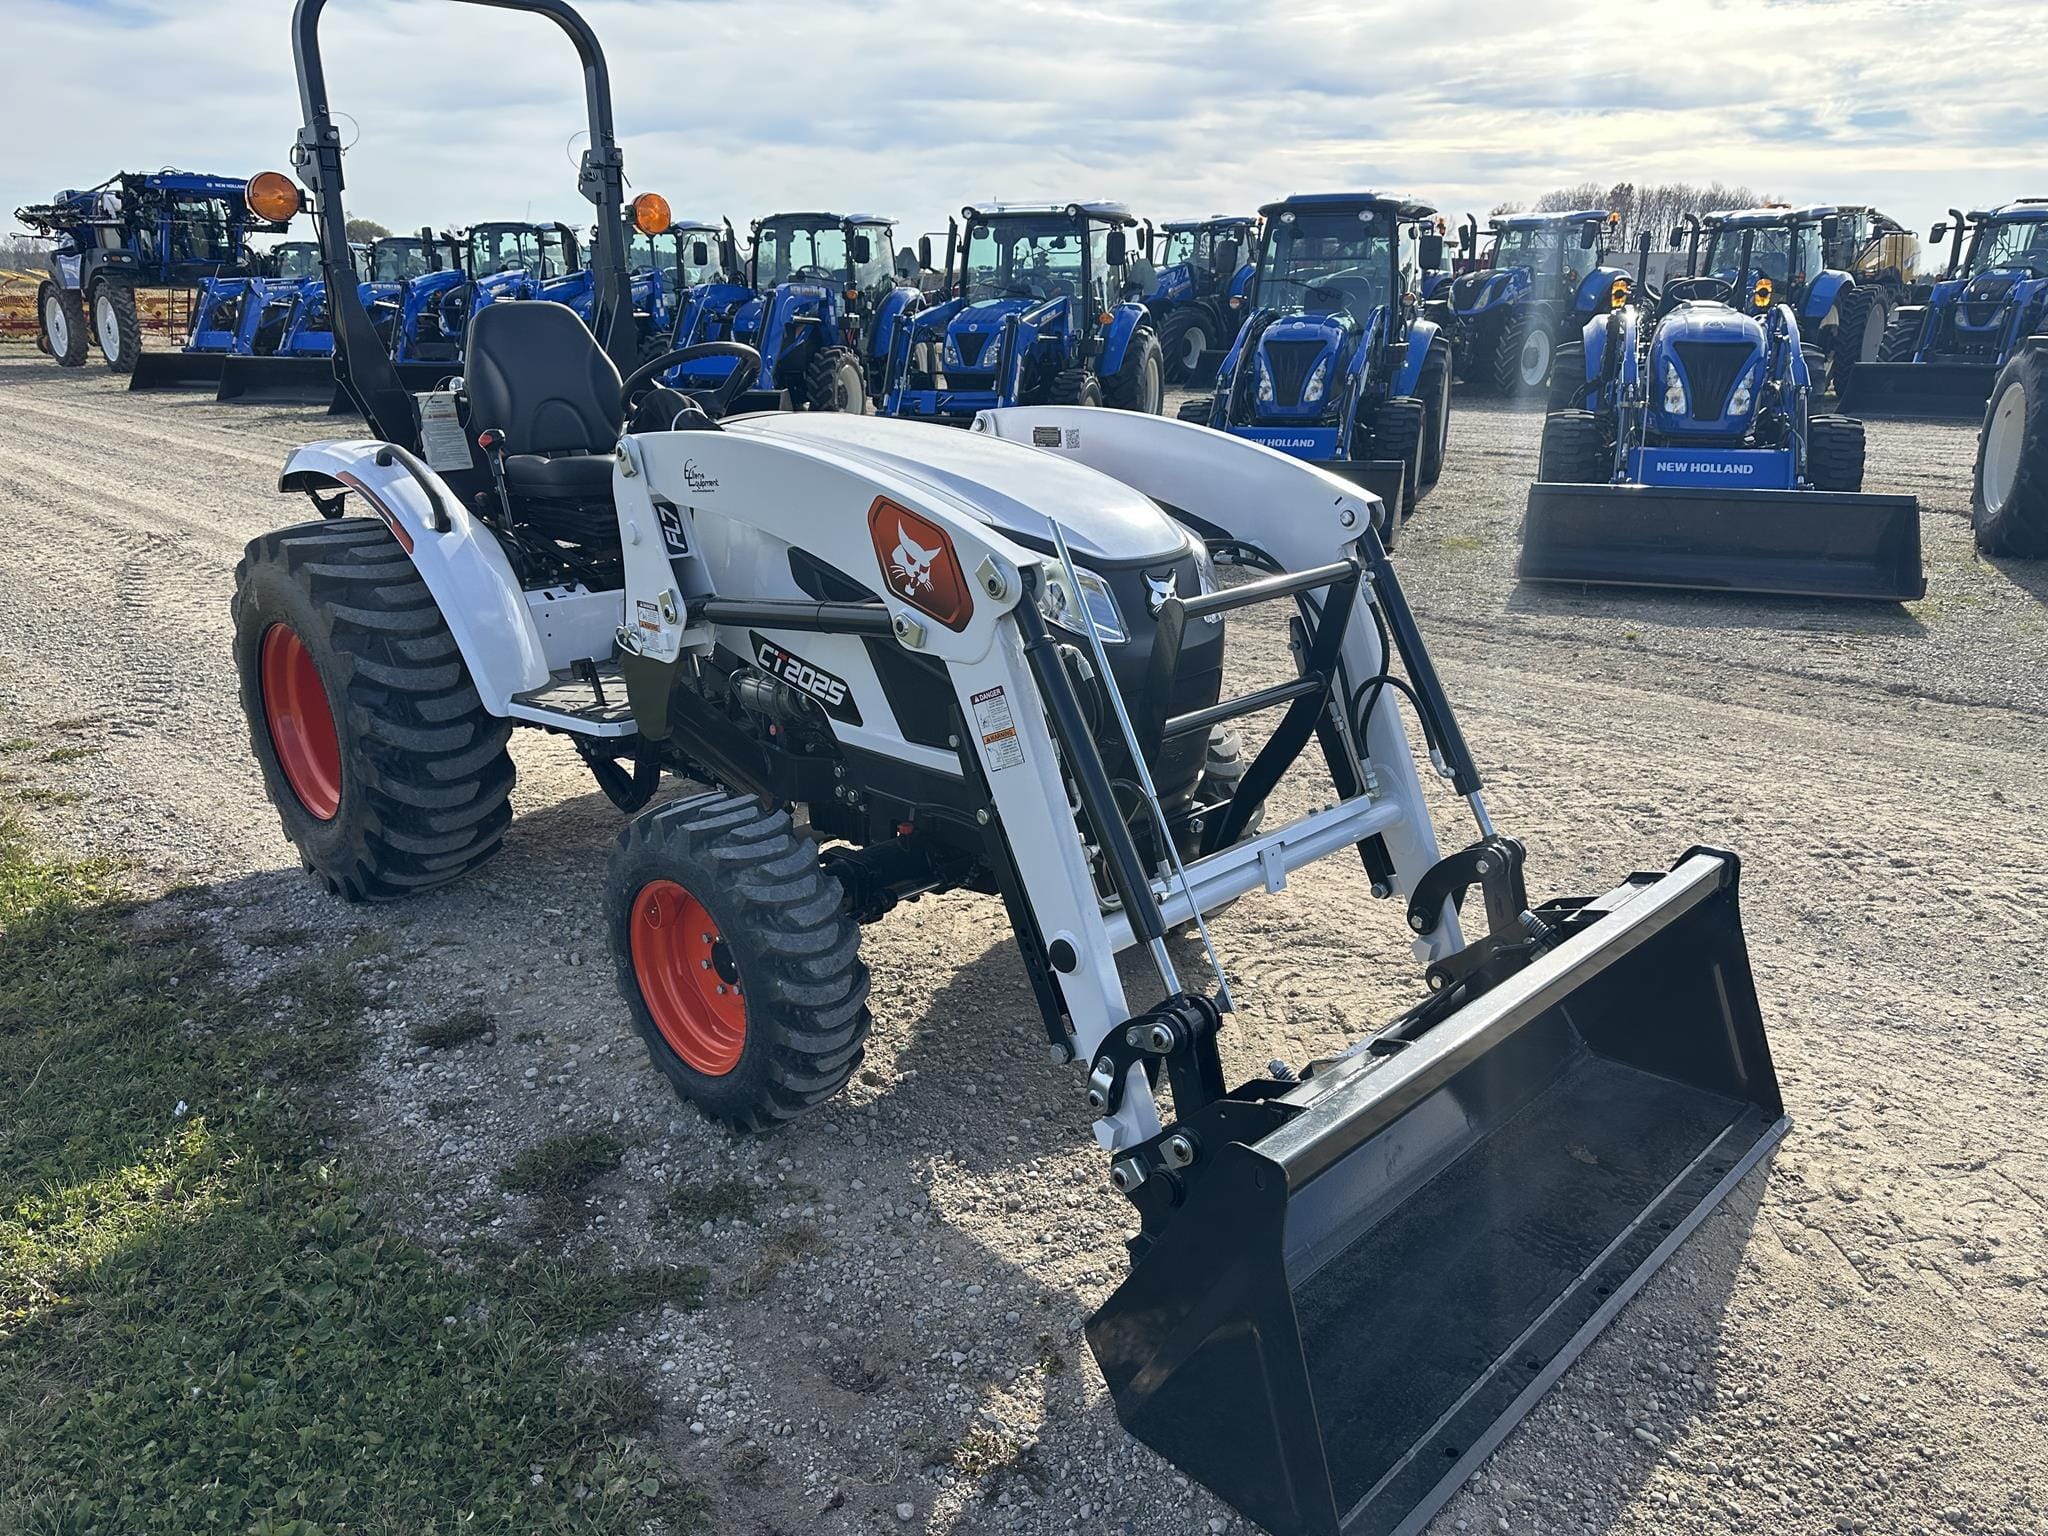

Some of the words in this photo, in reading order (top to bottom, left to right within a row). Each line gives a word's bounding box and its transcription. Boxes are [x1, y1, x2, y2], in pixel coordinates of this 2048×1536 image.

[1267, 439, 1315, 448] HOLLAND
[1656, 462, 1688, 472] NEW
[1690, 463, 1754, 474] HOLLAND
[657, 505, 686, 549] FL7
[758, 643, 847, 706] CT2025
[979, 688, 1002, 701] DANGER
[990, 729, 1014, 740] WARNING
